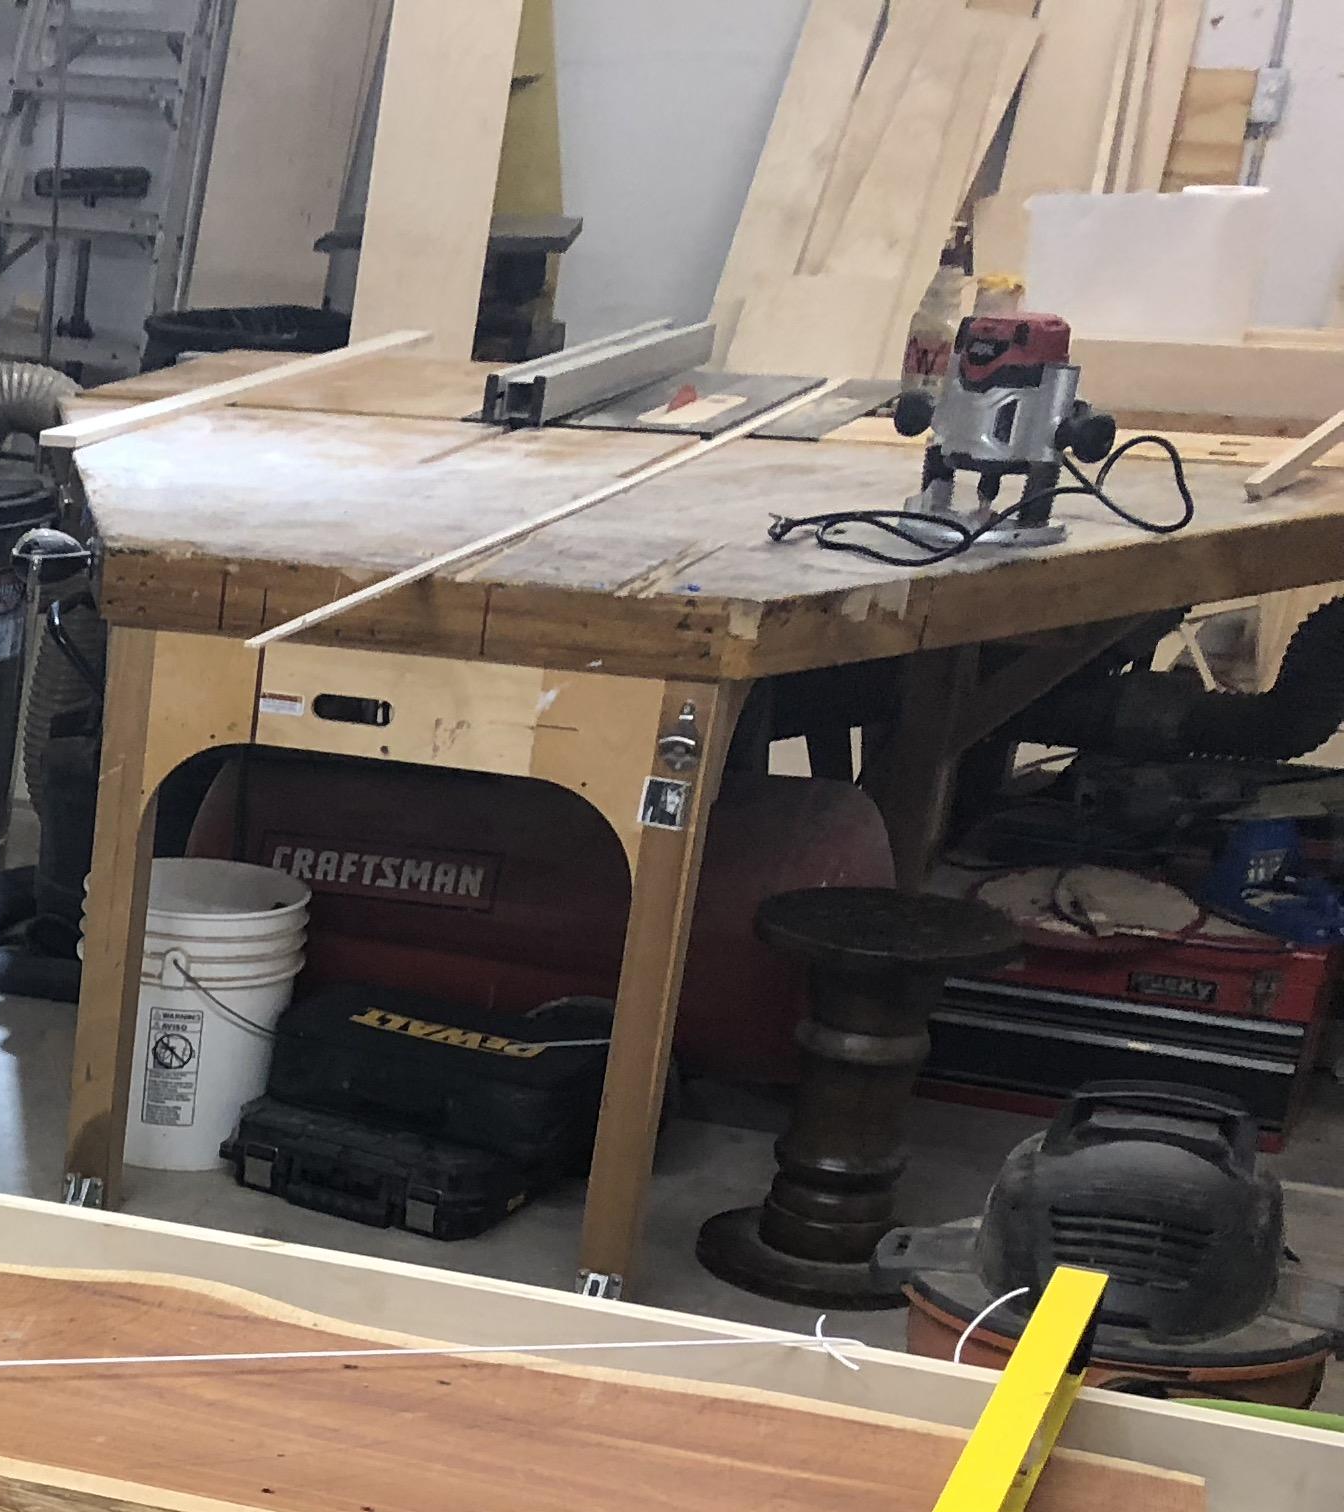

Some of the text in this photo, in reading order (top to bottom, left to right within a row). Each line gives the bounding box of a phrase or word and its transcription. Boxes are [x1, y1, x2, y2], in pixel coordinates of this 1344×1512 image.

[272, 846, 485, 898] CRAFTSMAN
[161, 1011, 201, 1022] WARNING
[161, 1022, 189, 1033] AVISO
[349, 1006, 547, 1059] DEWALT
